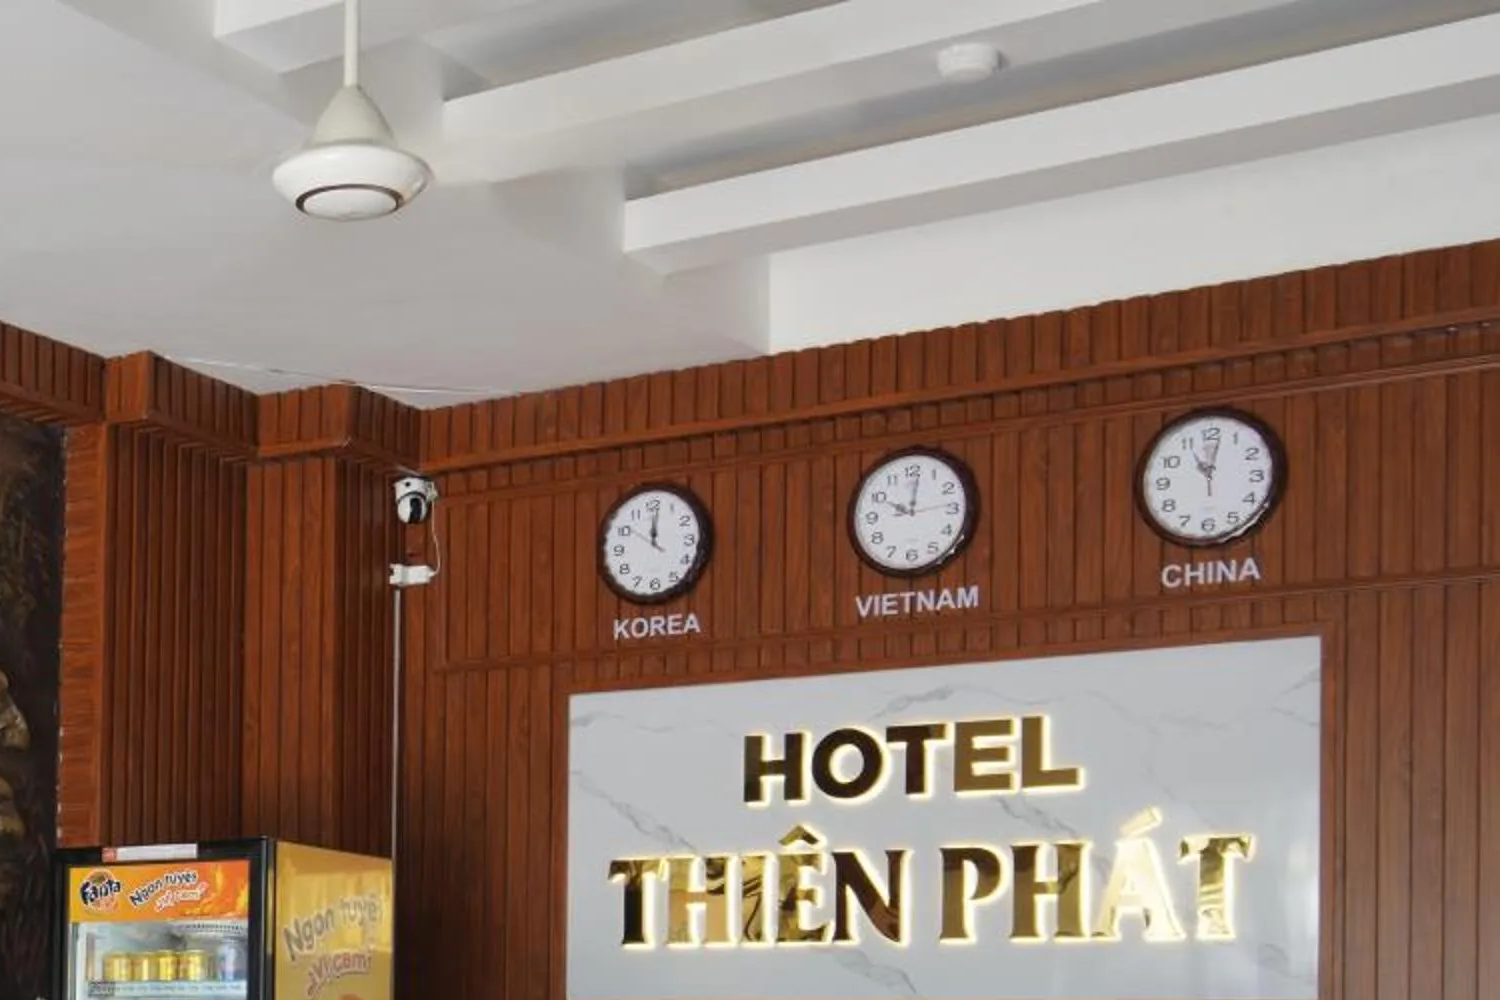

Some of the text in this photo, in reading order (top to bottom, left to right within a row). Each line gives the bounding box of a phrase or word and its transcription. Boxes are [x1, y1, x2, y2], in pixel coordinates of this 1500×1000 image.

[1202, 427, 1221, 441] 12
[1245, 447, 1259, 461] 2
[1163, 455, 1181, 469] 10
[904, 465, 921, 478] 12
[1248, 469, 1264, 483] 3
[941, 482, 956, 495] 2
[1156, 477, 1171, 491] 9
[871, 491, 887, 504] 10
[1242, 492, 1255, 505] 4
[945, 501, 960, 515] 3
[1162, 499, 1176, 512] 8
[866, 511, 878, 525] 9
[1179, 515, 1191, 527] 7
[1201, 518, 1216, 532] 6
[1227, 512, 1239, 525] 5
[941, 524, 952, 536] 4
[871, 532, 884, 545] 8
[887, 546, 897, 558] 7
[927, 541, 939, 554] 5
[905, 549, 918, 562] 6
[1160, 557, 1261, 589] CHINA
[855, 586, 980, 618] VIETNAM
[613, 613, 701, 640] KOREA
[743, 716, 1081, 803] HOTEL
[608, 807, 1254, 946] THIÊN PHÁT
[80, 878, 121, 906] Fanta
[284, 908, 335, 961] Ngon
